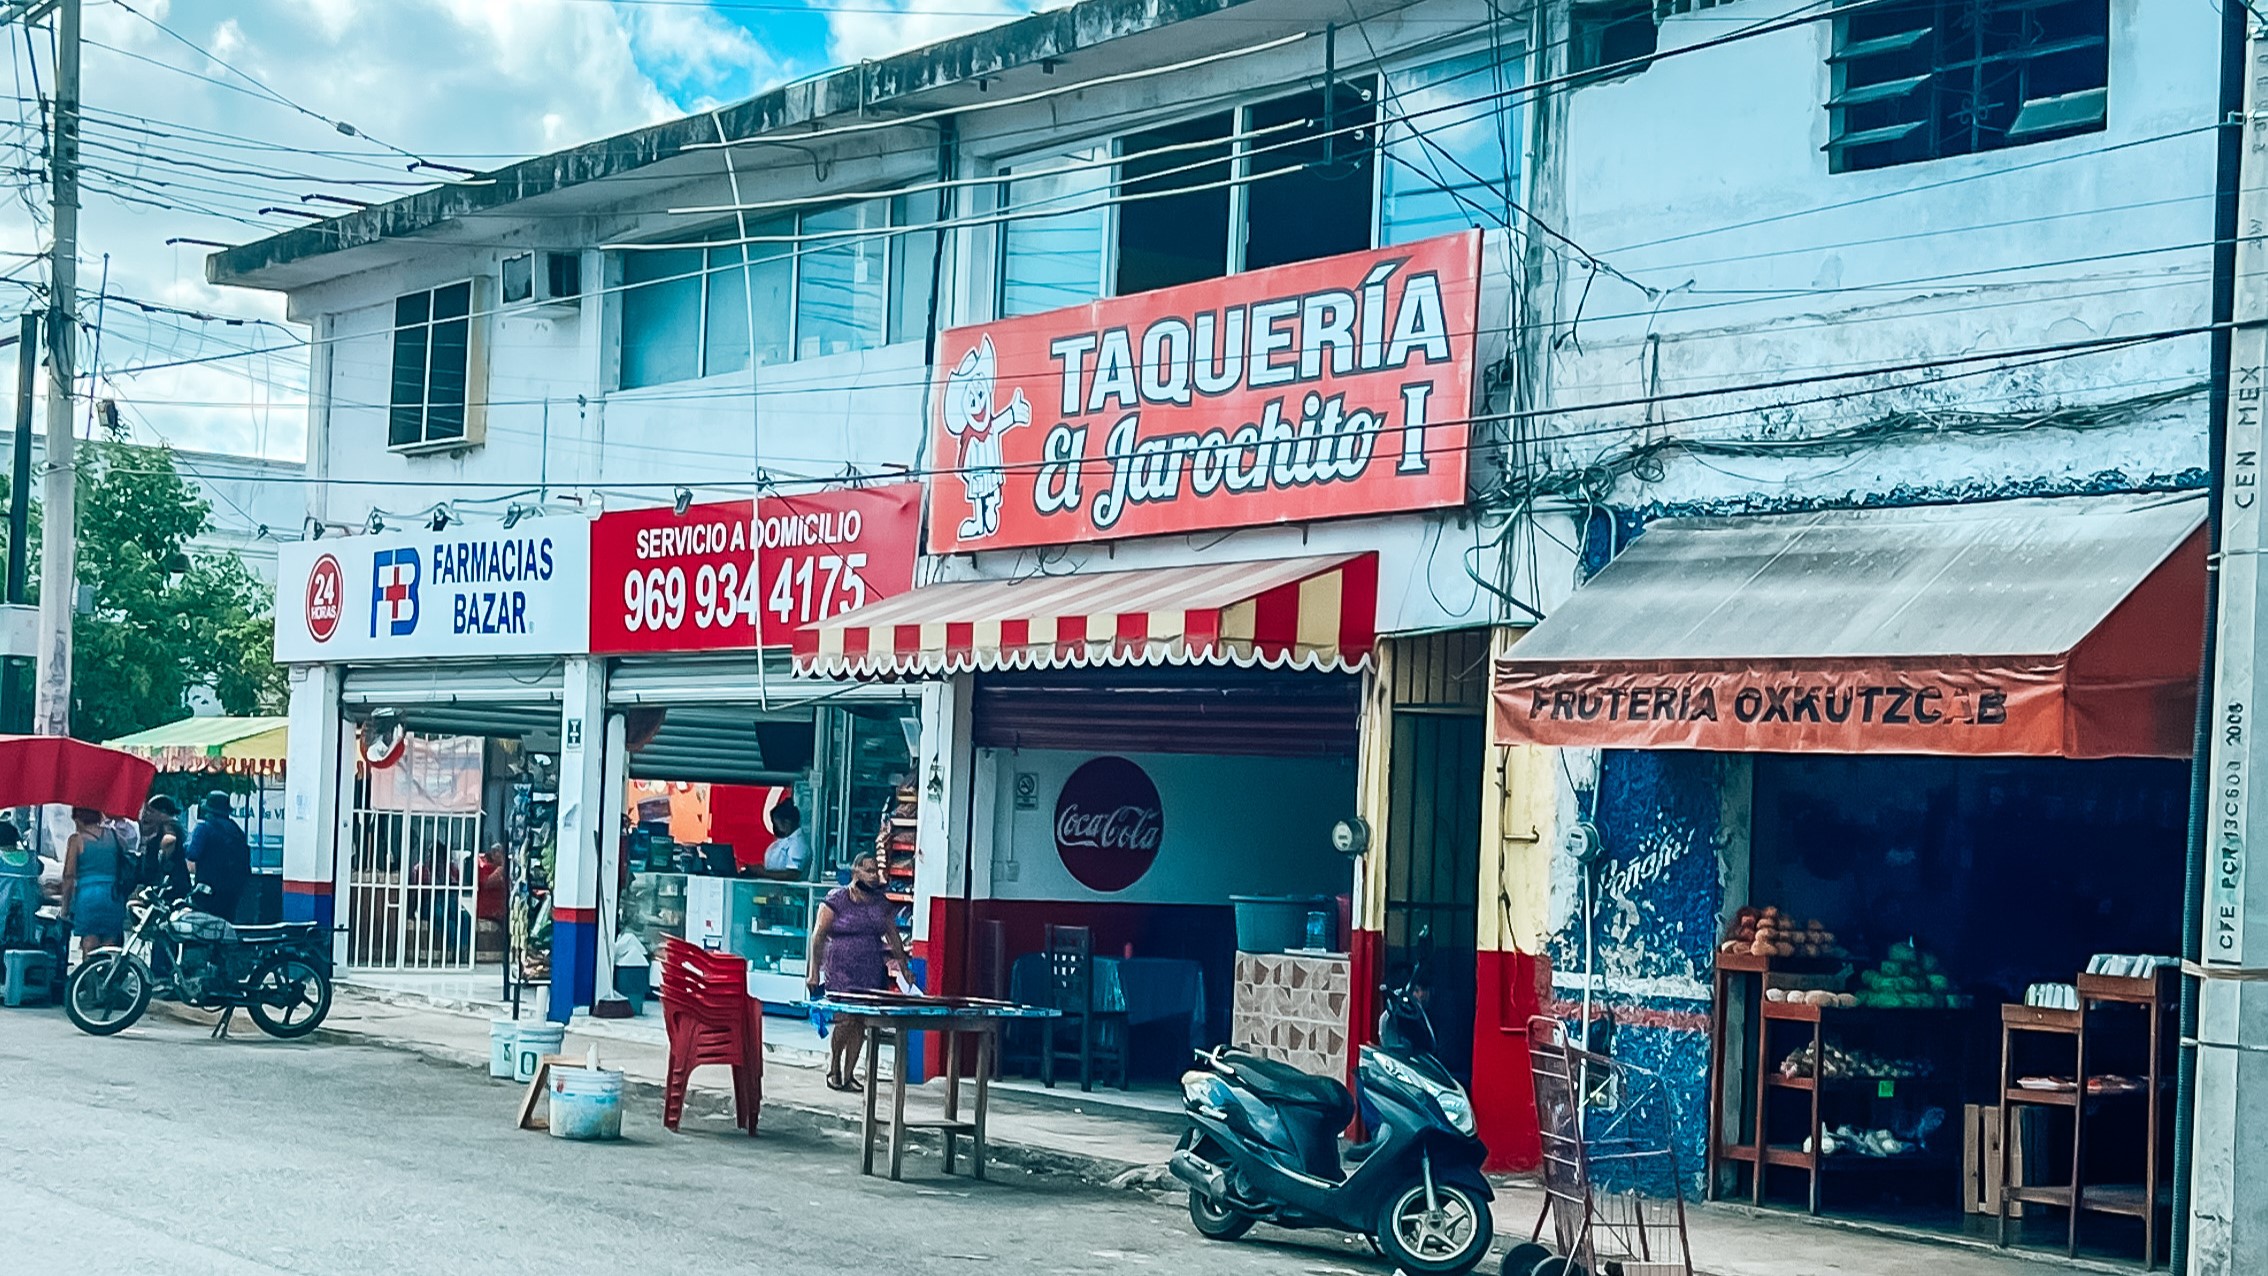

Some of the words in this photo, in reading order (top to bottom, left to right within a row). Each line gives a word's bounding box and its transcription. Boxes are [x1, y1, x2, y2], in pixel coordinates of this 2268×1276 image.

[1049, 256, 1452, 416] TAQUERÍA
[2238, 365, 2261, 426] MEX
[1033, 423, 1088, 516] El
[1092, 391, 1387, 530] Jarochito
[1396, 381, 1433, 476] I
[2235, 450, 2257, 508] CEN
[636, 522, 727, 559] SERVICIO
[729, 520, 746, 551] A
[749, 509, 862, 550] DOMICILIO
[432, 538, 554, 586] FARMACIAS
[311, 605, 337, 620] HORAS
[313, 572, 335, 606] 24
[453, 591, 527, 635] BAZAR
[624, 565, 686, 632] 969
[694, 561, 761, 628] 934
[768, 552, 868, 624] 4175
[2218, 903, 2237, 952] CFE
